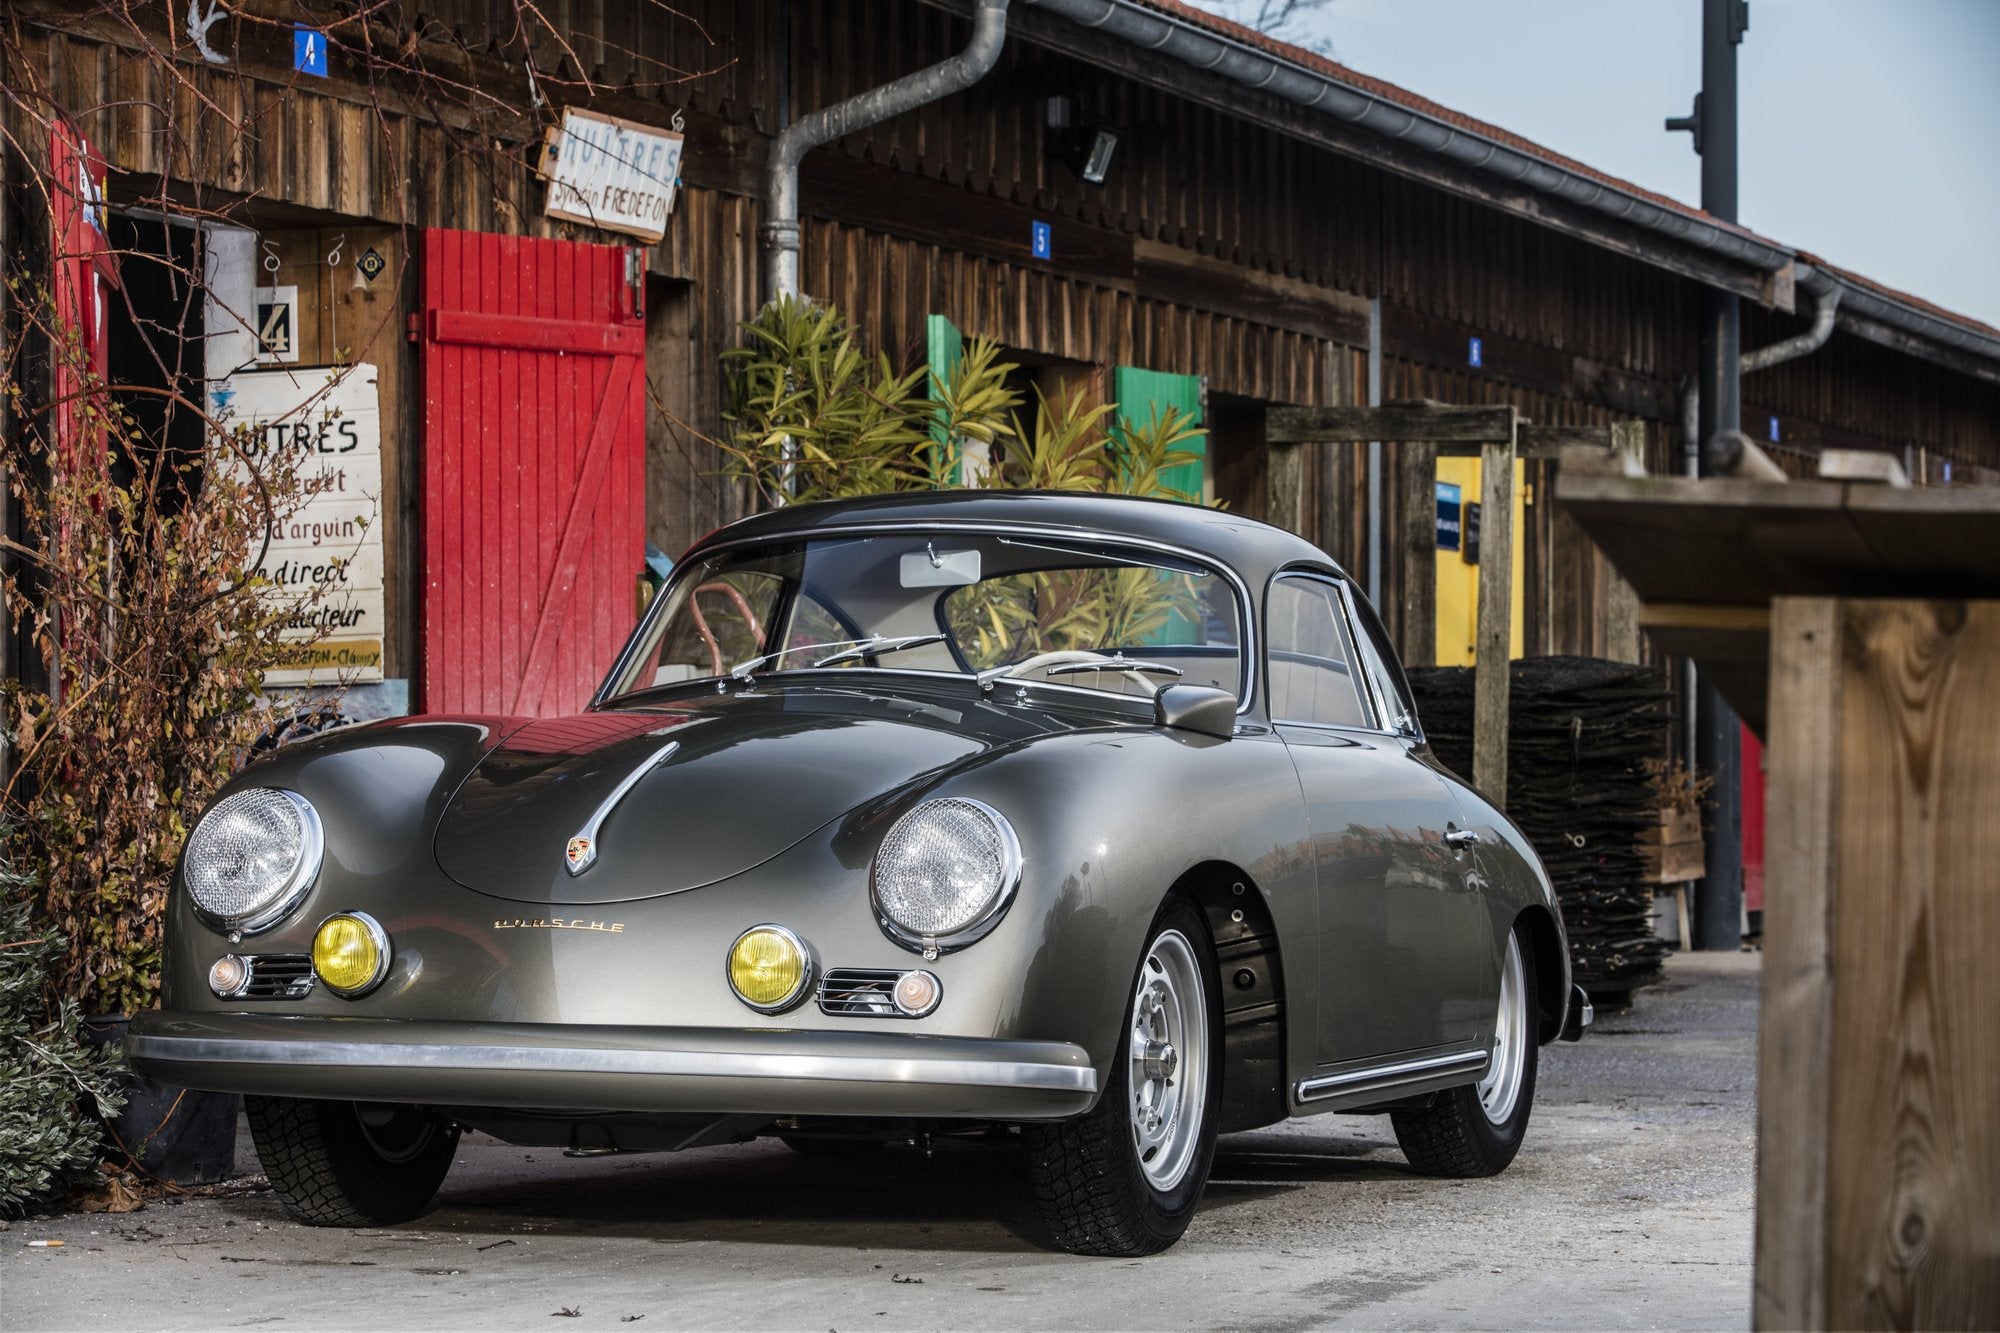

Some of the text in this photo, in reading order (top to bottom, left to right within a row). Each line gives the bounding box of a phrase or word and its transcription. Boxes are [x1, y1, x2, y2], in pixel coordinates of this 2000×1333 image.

[306, 33, 315, 66] 4
[1038, 227, 1045, 252] 5
[260, 304, 289, 351] 4
[275, 560, 348, 585] direct
[494, 918, 625, 933] PORSCHE
